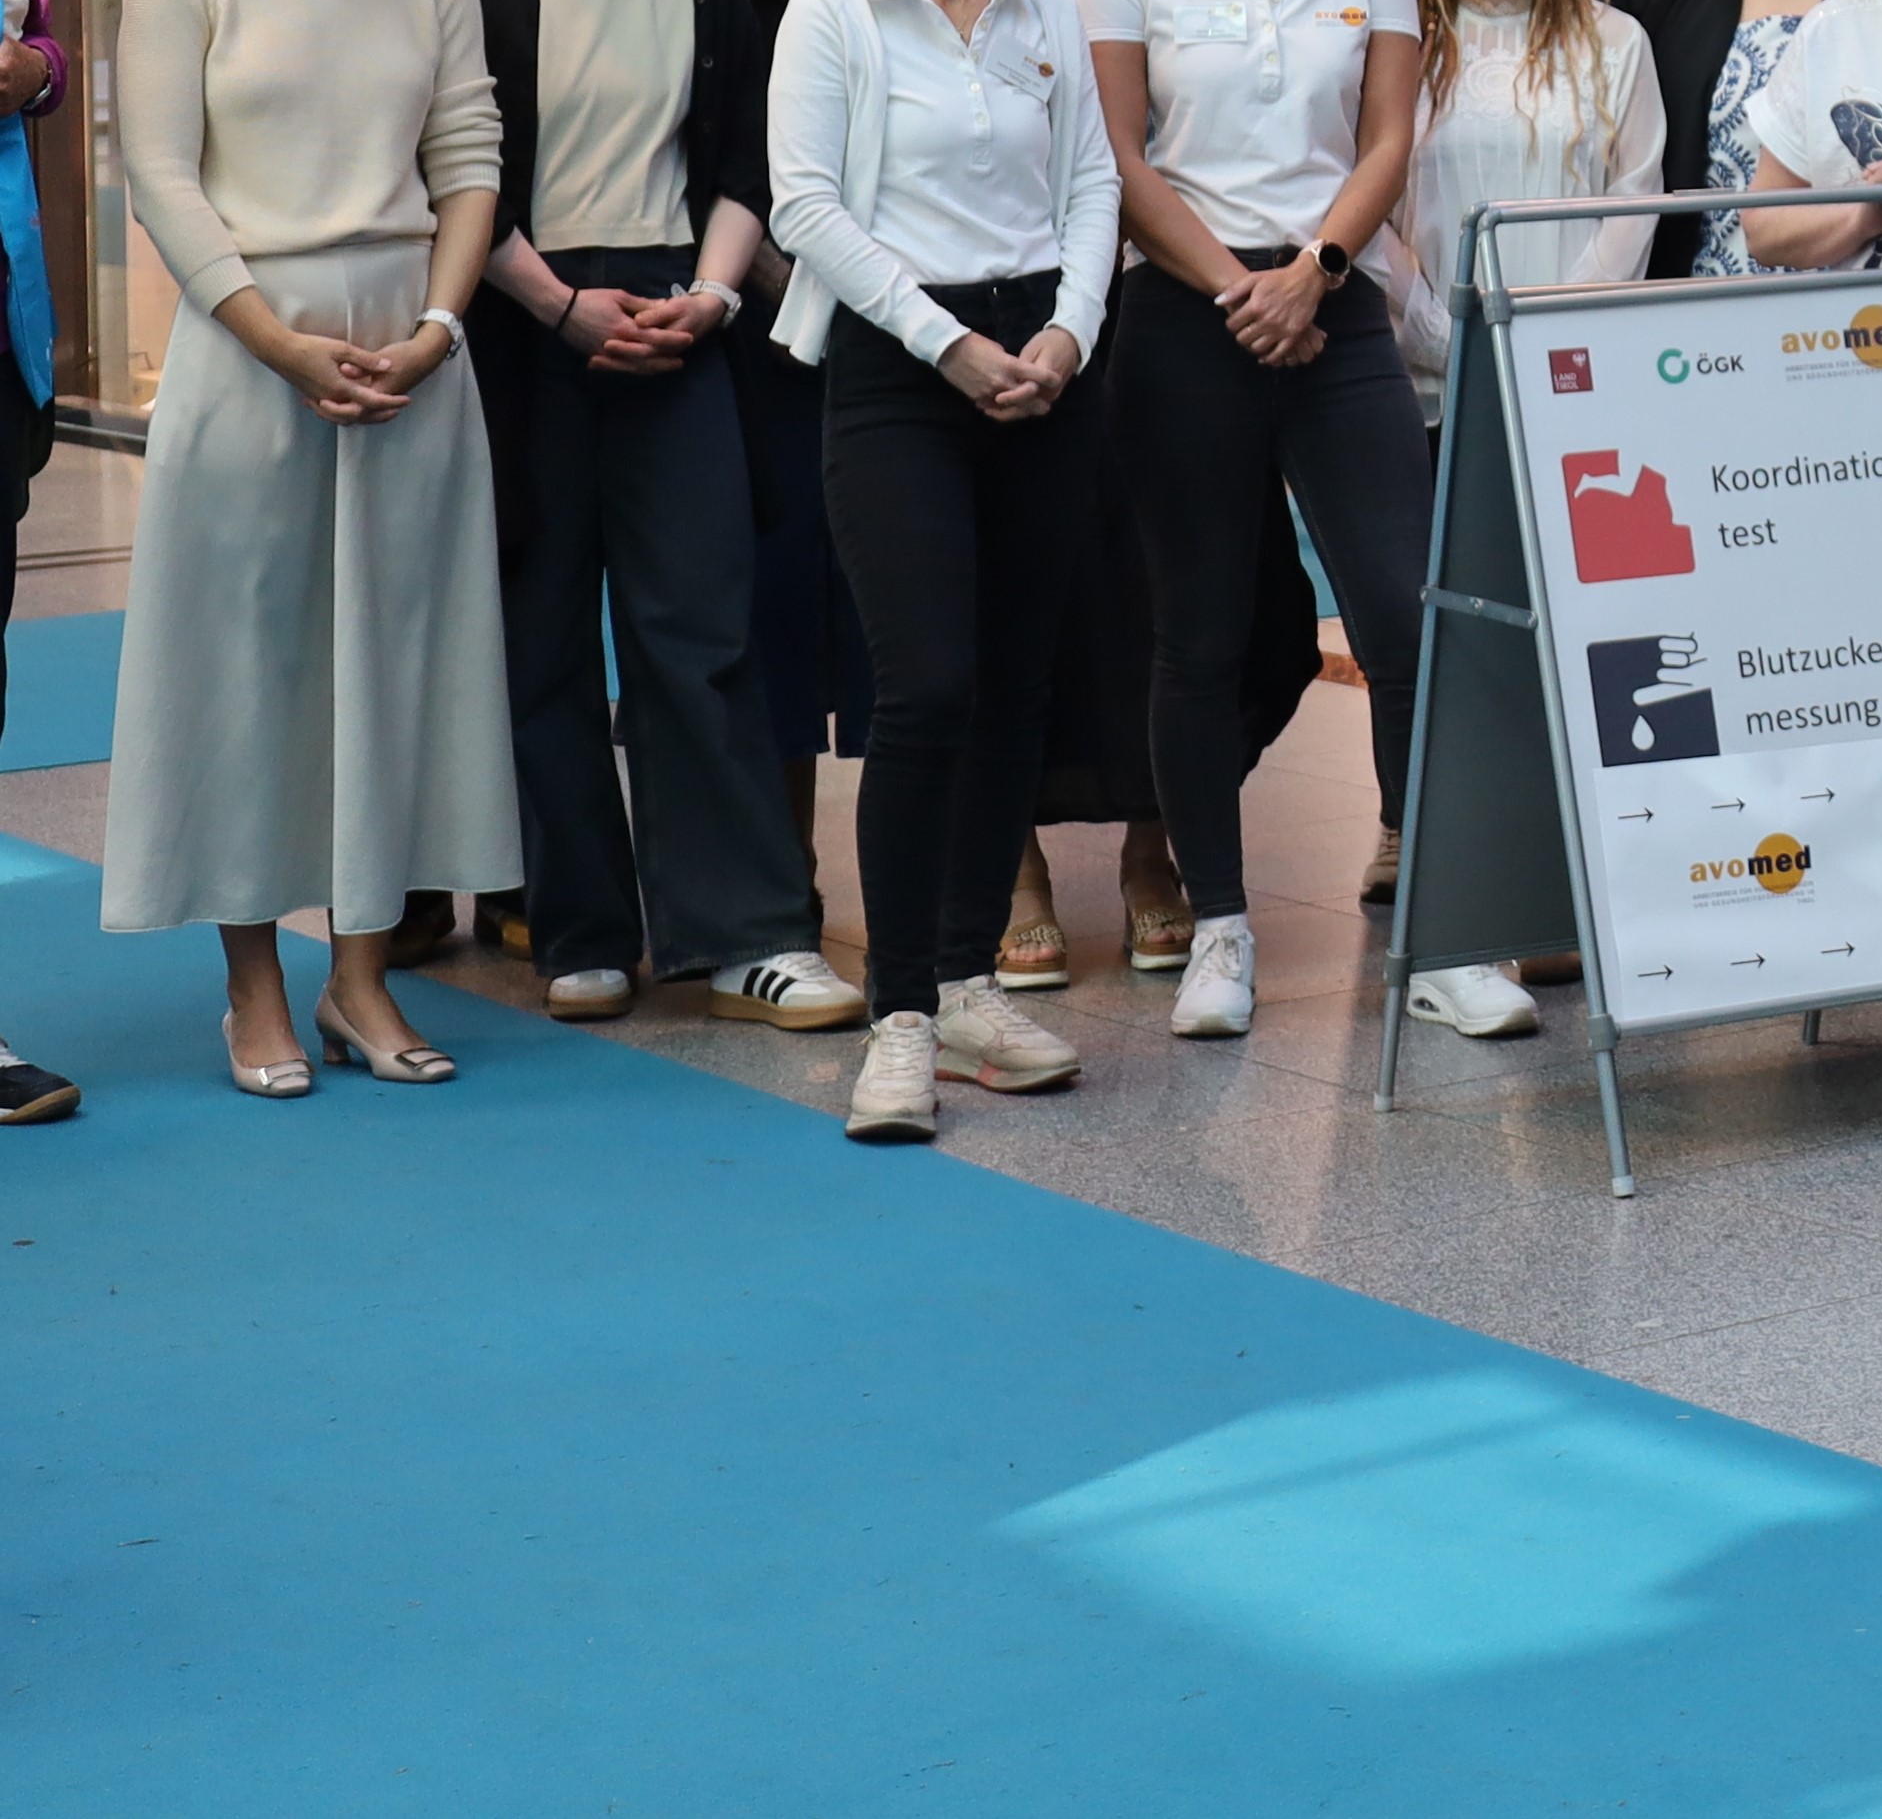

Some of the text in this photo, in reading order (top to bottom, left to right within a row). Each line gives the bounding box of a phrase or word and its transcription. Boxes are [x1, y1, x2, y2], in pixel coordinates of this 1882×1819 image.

[1696, 353, 1744, 375] ÖGK
[1717, 518, 1778, 549] test
[1746, 697, 1882, 735] messung
[1689, 844, 1812, 882] avomed
